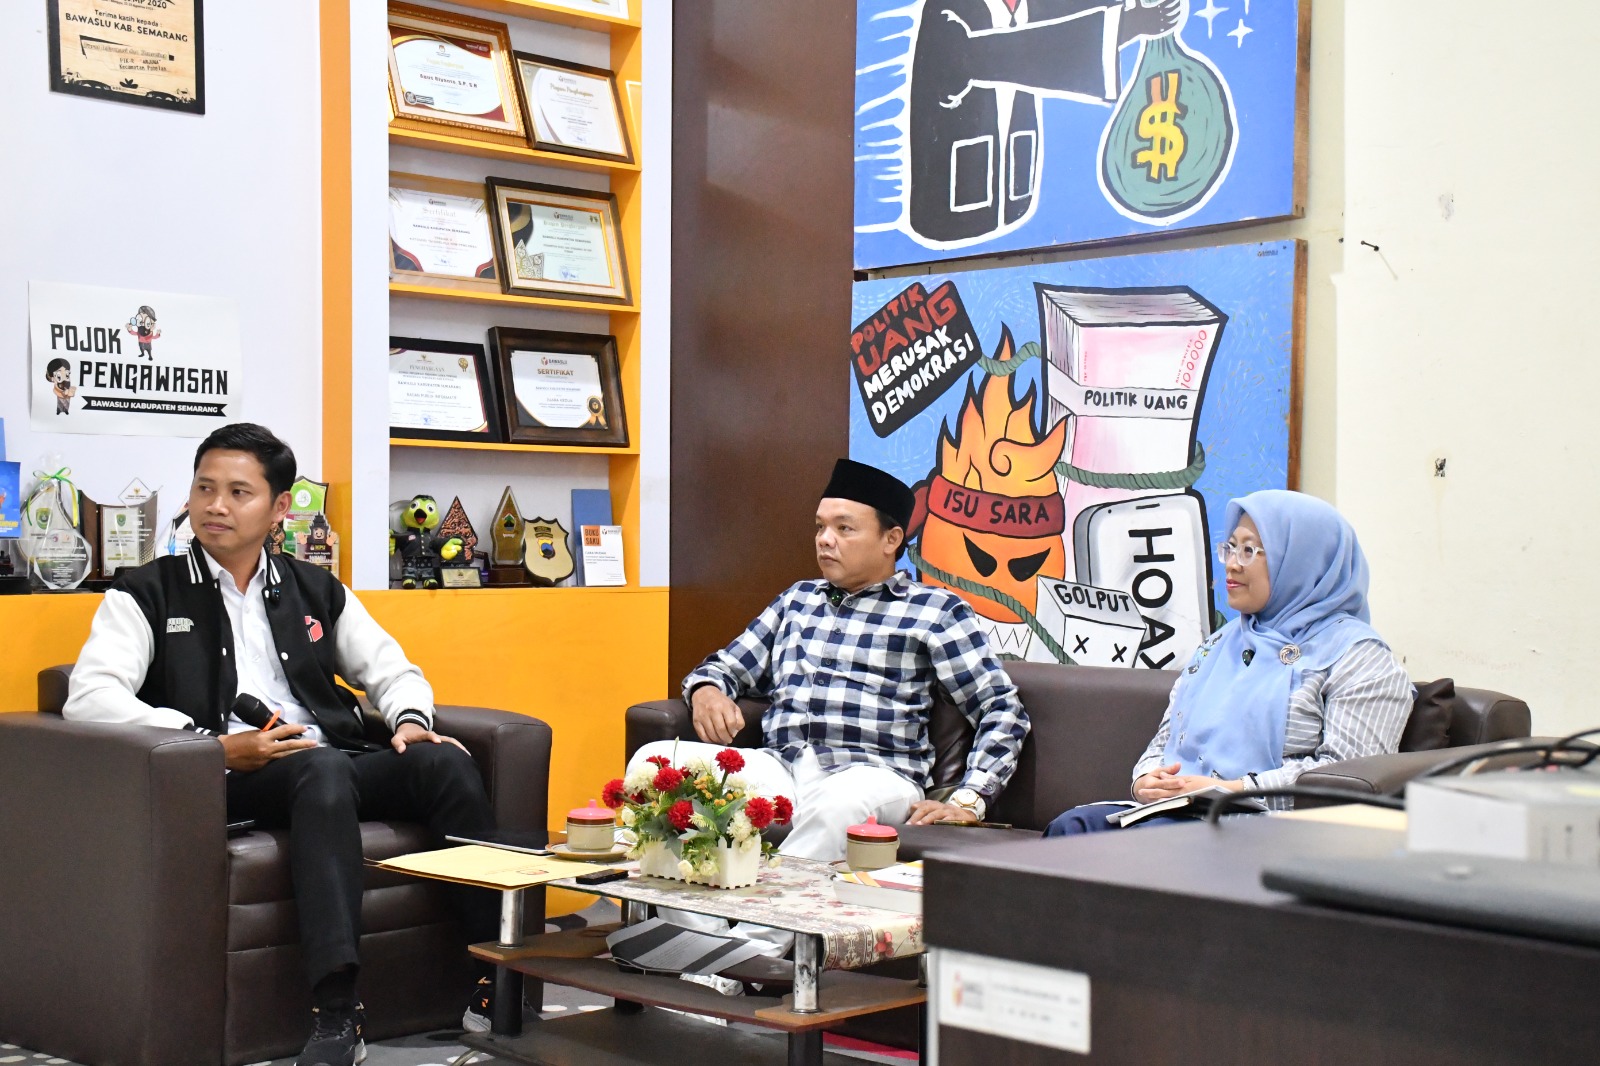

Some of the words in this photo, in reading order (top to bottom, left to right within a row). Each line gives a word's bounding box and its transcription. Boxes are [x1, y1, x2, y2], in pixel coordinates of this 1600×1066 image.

[65, 12, 111, 28] BAWASLU
[114, 22, 135, 33] KAB.
[137, 26, 188, 42] SEMARANG
[94, 9, 117, 20] Terima
[118, 13, 135, 22] kasih
[851, 284, 924, 354] POLITIK
[858, 284, 957, 377] UANG
[50, 323, 122, 354] POJOK
[537, 368, 574, 376] SERTIFIKAT
[863, 325, 952, 399] MERUSAK
[79, 360, 228, 395] PENGAWASAN
[871, 332, 974, 424] DEMOKRASI
[91, 399, 130, 409] BAWASLU
[130, 401, 176, 412] KABUPATEN
[177, 404, 218, 413] SEMARANG
[1084, 389, 1137, 407] POLITIK
[1144, 394, 1188, 410] UANG
[943, 489, 978, 518] ISU
[989, 500, 1050, 526] SARA
[585, 537, 600, 545] SAKU
[1053, 583, 1129, 613] GOLPUT
